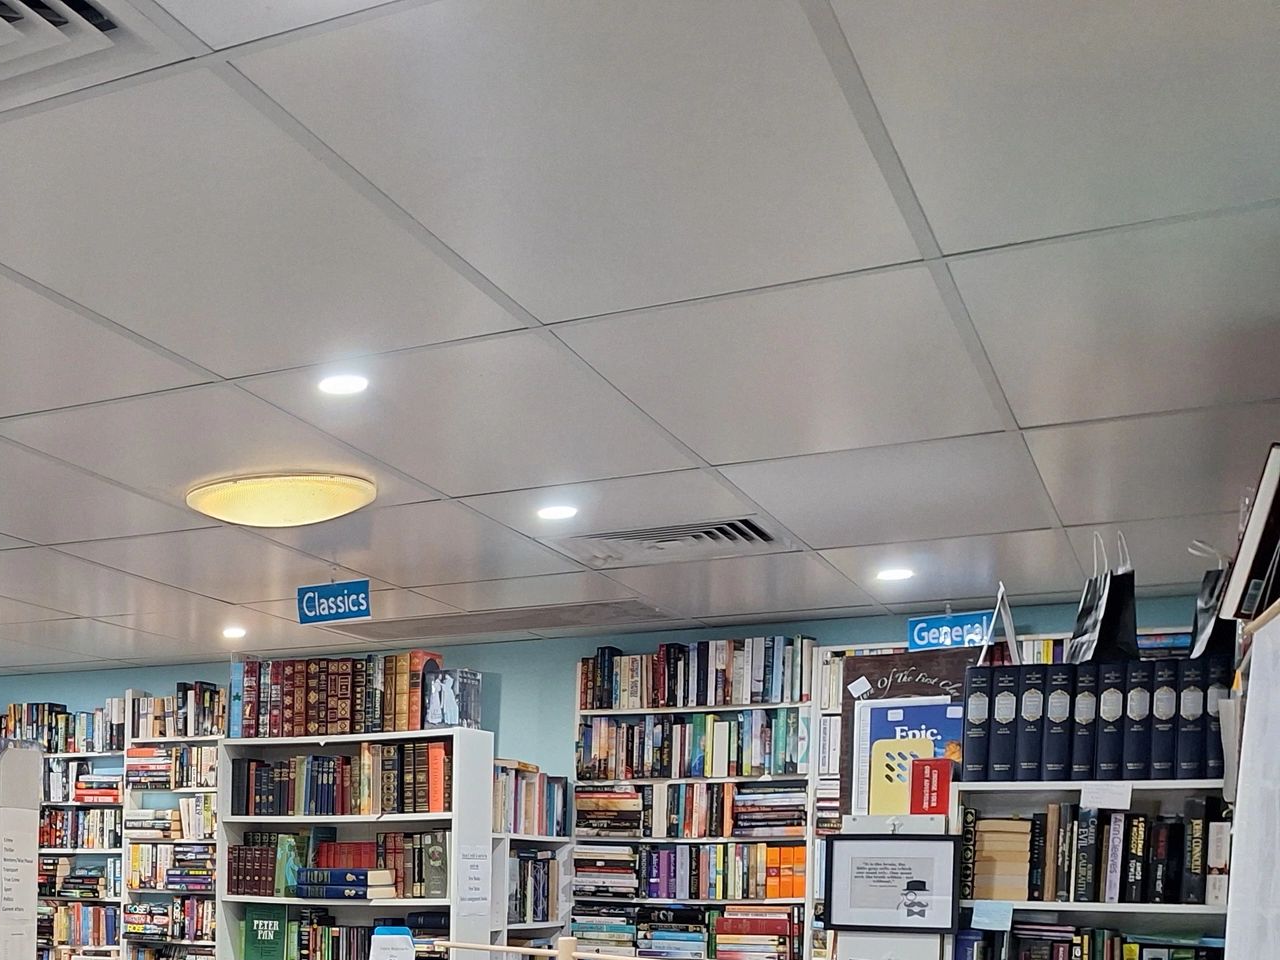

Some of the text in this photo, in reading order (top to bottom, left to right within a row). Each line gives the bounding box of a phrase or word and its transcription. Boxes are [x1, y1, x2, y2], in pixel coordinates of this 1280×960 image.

[302, 592, 366, 616] Classics
[914, 616, 987, 646] General
[878, 669, 895, 698] Of
[896, 667, 916, 682] The
[1078, 828, 1088, 849] EVIL
[1088, 818, 1097, 845] CAREER
[1110, 817, 1122, 874] Ann Cleeves
[1130, 827, 1138, 854] MOSCOW
[1136, 822, 1145, 856] GENTLEMAN
[1191, 819, 1203, 874] JOHN CONNOLLY
[1078, 852, 1087, 894] GALBRAITH
[253, 919, 279, 930] PETER
[257, 930, 274, 940] PAN
